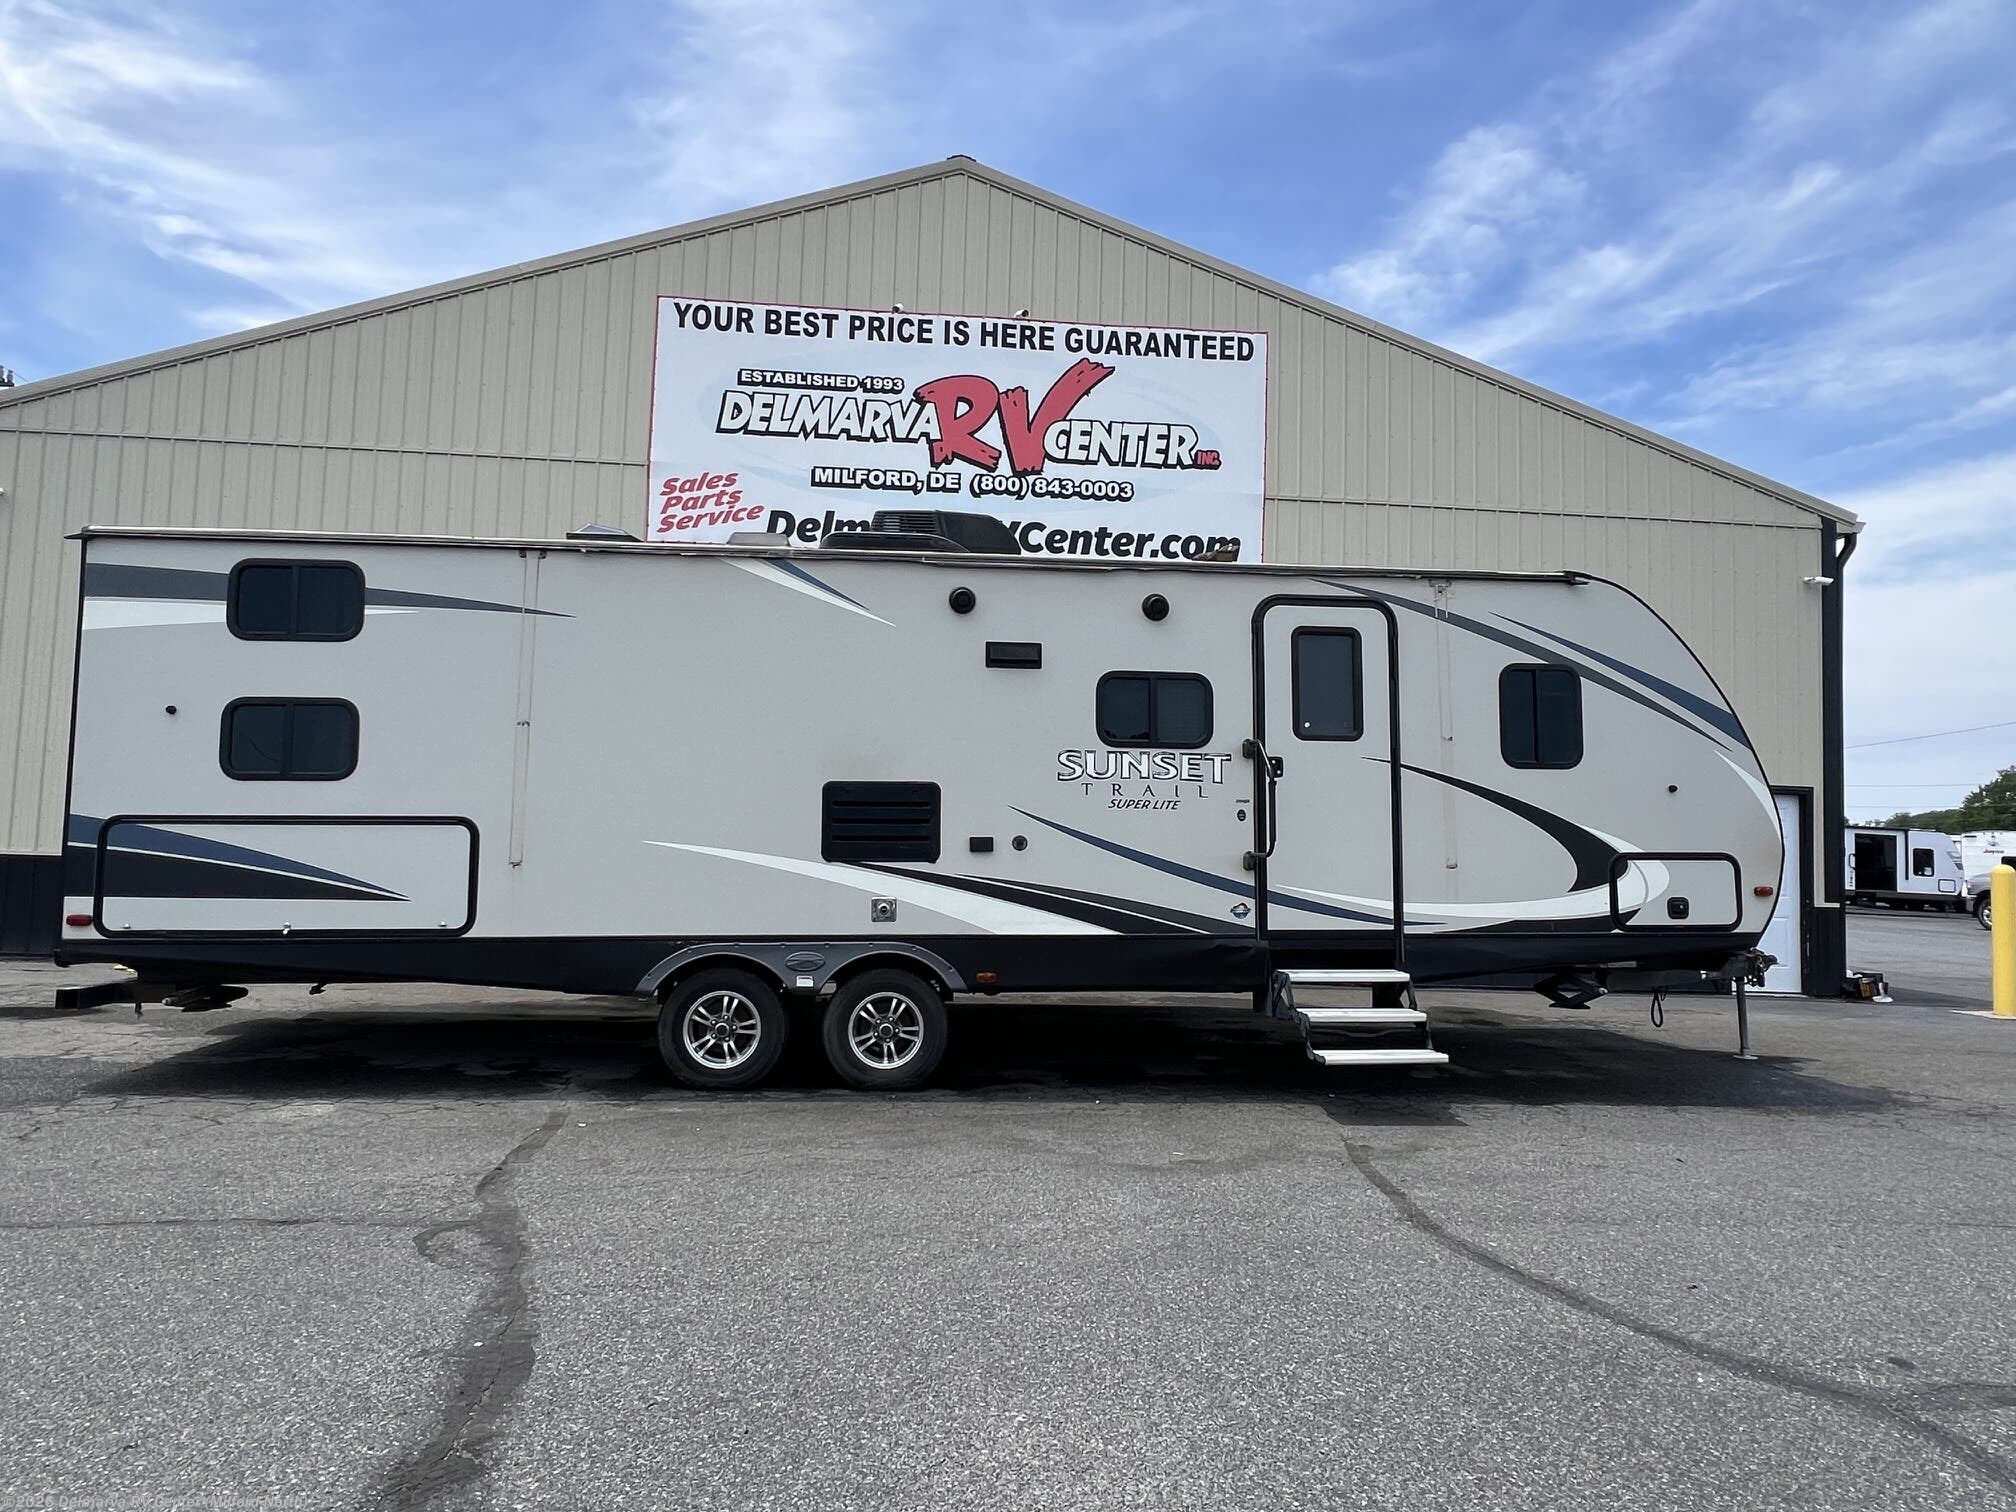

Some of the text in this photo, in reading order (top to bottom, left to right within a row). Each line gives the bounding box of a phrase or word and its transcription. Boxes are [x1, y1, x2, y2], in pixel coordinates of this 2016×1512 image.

[674, 302, 1254, 361] YOUR BEST PRICE IS HERE GUARANTEED
[738, 369, 904, 393] ESTABLISHED 1993
[716, 390, 942, 443] DELMARVA
[914, 358, 1116, 475] RV
[1043, 419, 1199, 469] CENTER
[660, 472, 739, 496] Sales
[811, 466, 1135, 501] MILFORD, DE (800) 843-0003
[660, 488, 743, 514] Parts
[657, 504, 764, 533] Service
[1057, 750, 1232, 784] SUNSET
[1081, 783, 1208, 798] TRAIL
[1108, 799, 1181, 810] SUPER LITE
